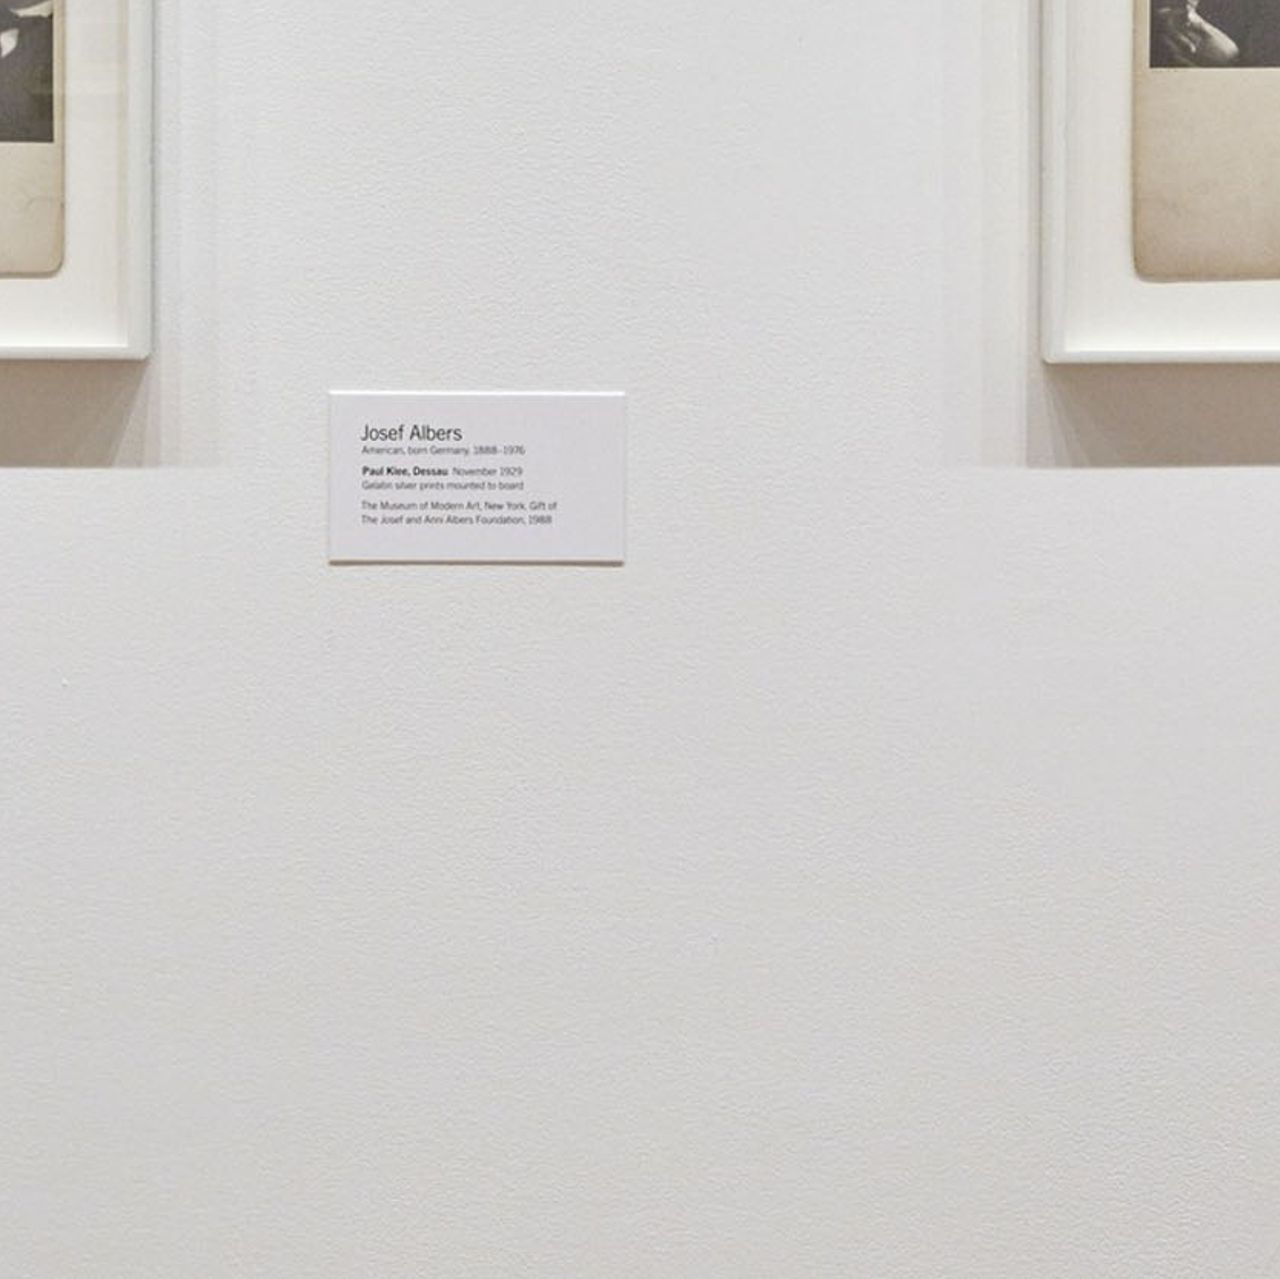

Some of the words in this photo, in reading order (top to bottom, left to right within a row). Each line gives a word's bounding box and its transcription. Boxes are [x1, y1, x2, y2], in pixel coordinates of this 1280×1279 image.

[360, 424, 404, 441] Josef
[409, 424, 463, 441] Albers
[408, 445, 427, 455] born
[362, 465, 384, 476] Paul
[386, 465, 411, 477] Klee,
[452, 466, 497, 476] November
[361, 480, 393, 490] Gelatin
[395, 480, 417, 490] silver
[419, 481, 444, 491] prints
[446, 481, 485, 491] mounted
[487, 481, 496, 491] to
[498, 481, 524, 491] board
[361, 500, 378, 510] The
[380, 500, 418, 511] Museum
[420, 500, 429, 510] of
[431, 501, 464, 511] Modern
[484, 501, 504, 511] New
[529, 500, 546, 511] Gift
[548, 501, 558, 511] of
[361, 514, 378, 525] The
[380, 514, 403, 525] Josef
[405, 515, 422, 525] and
[445, 515, 473, 525] Albers
